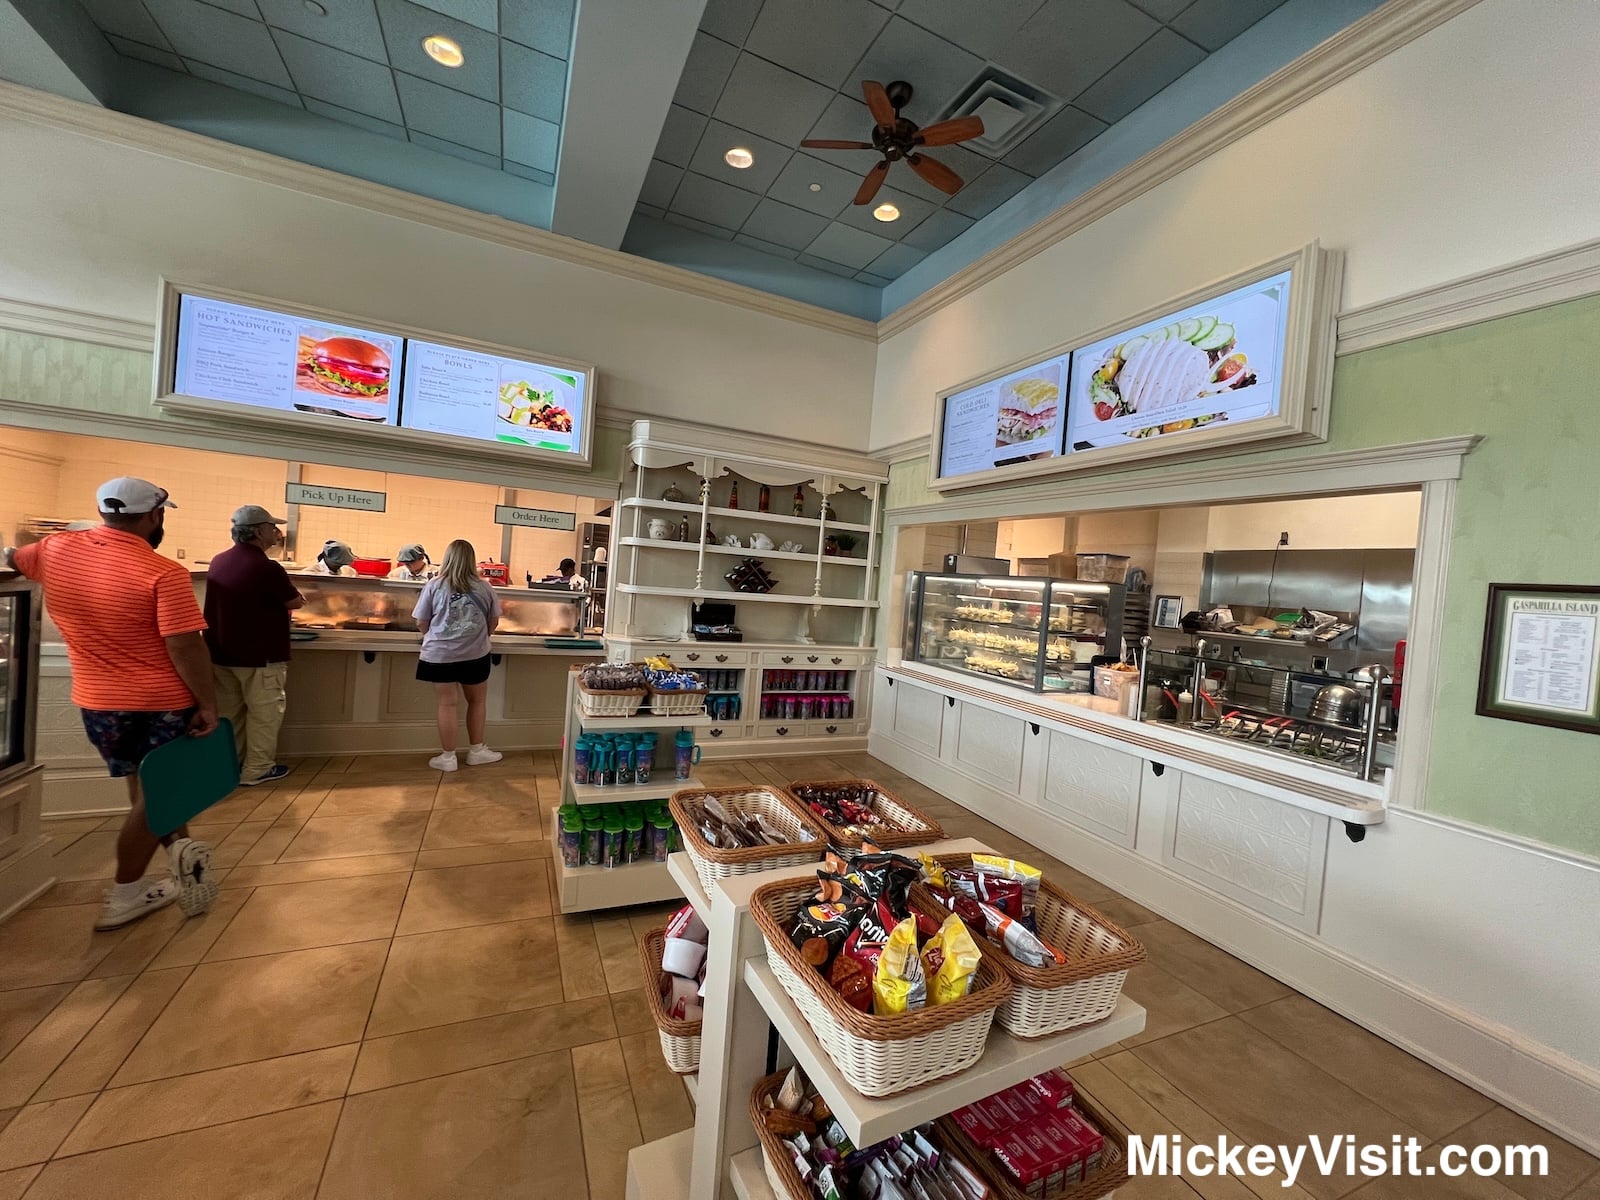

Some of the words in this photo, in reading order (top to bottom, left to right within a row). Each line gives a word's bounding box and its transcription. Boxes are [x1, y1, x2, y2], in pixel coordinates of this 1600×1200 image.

[197, 312, 219, 322] HOT
[224, 318, 292, 336] SANDWICHES
[444, 360, 472, 370] BOWLS
[302, 490, 324, 500] Pick
[328, 492, 344, 504] Up
[348, 494, 372, 504] Here
[512, 512, 538, 521] Order
[540, 514, 560, 524] Here
[1513, 600, 1562, 610] GASPARILLA
[1566, 602, 1598, 614] ISLAND
